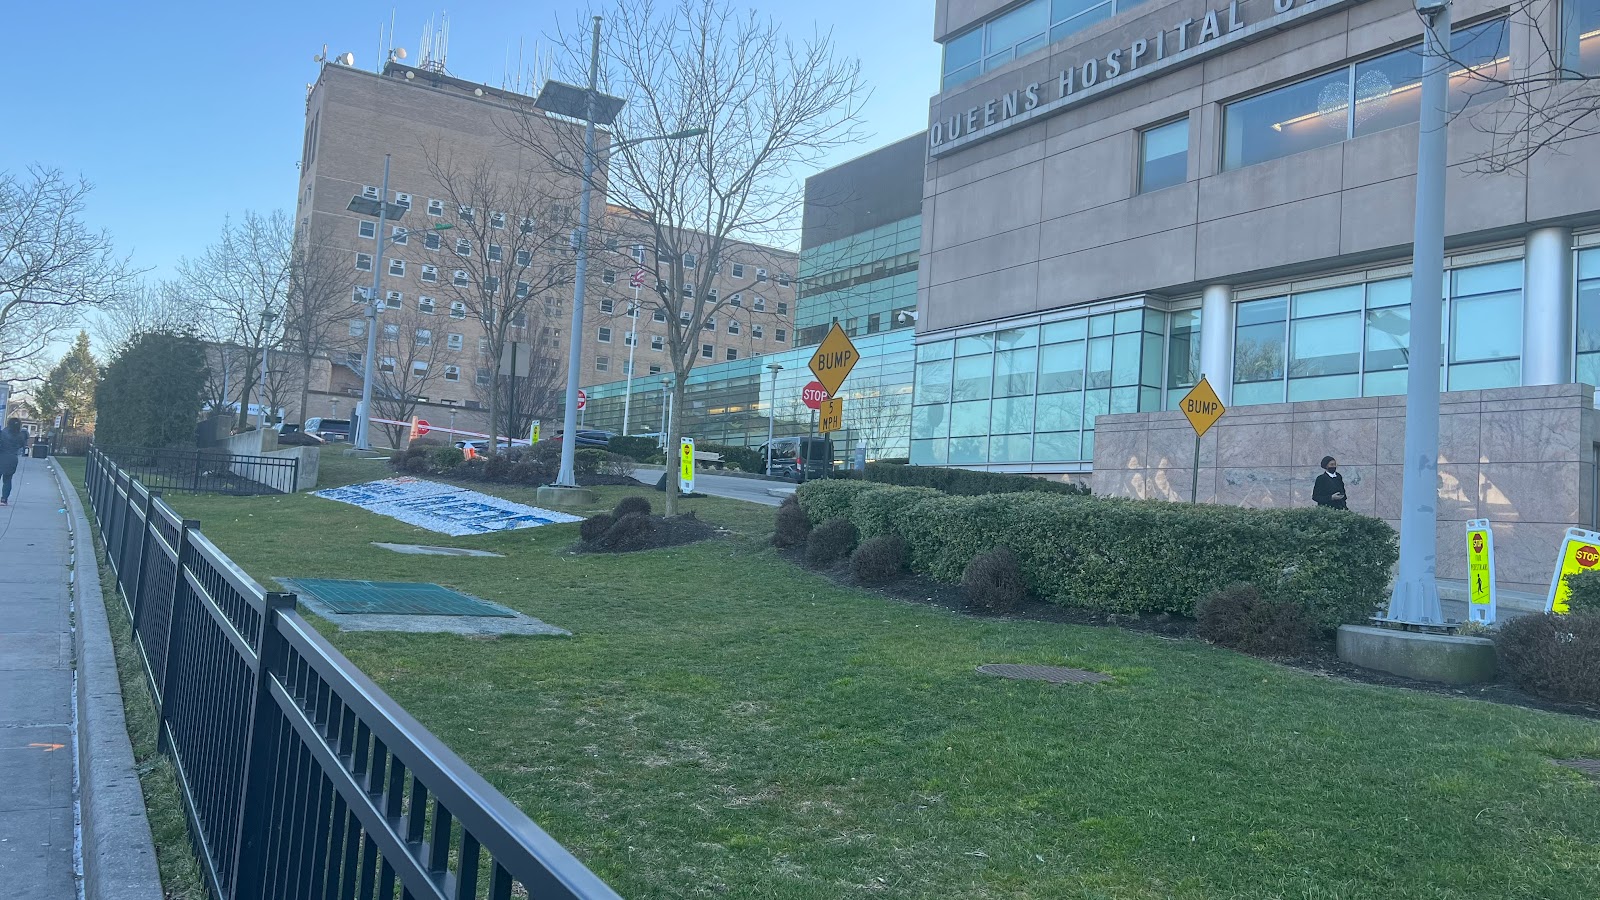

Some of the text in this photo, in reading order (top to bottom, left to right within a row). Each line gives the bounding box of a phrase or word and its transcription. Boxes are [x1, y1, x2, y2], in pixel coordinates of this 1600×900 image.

[930, 0, 1244, 147] QUEENS HOSPITAL
[818, 350, 851, 371] BUMP
[803, 389, 828, 401] STOP
[829, 402, 834, 414] 5
[1187, 399, 1218, 415] BUMP
[823, 416, 838, 430] MPH
[1576, 550, 1599, 561] STOP
